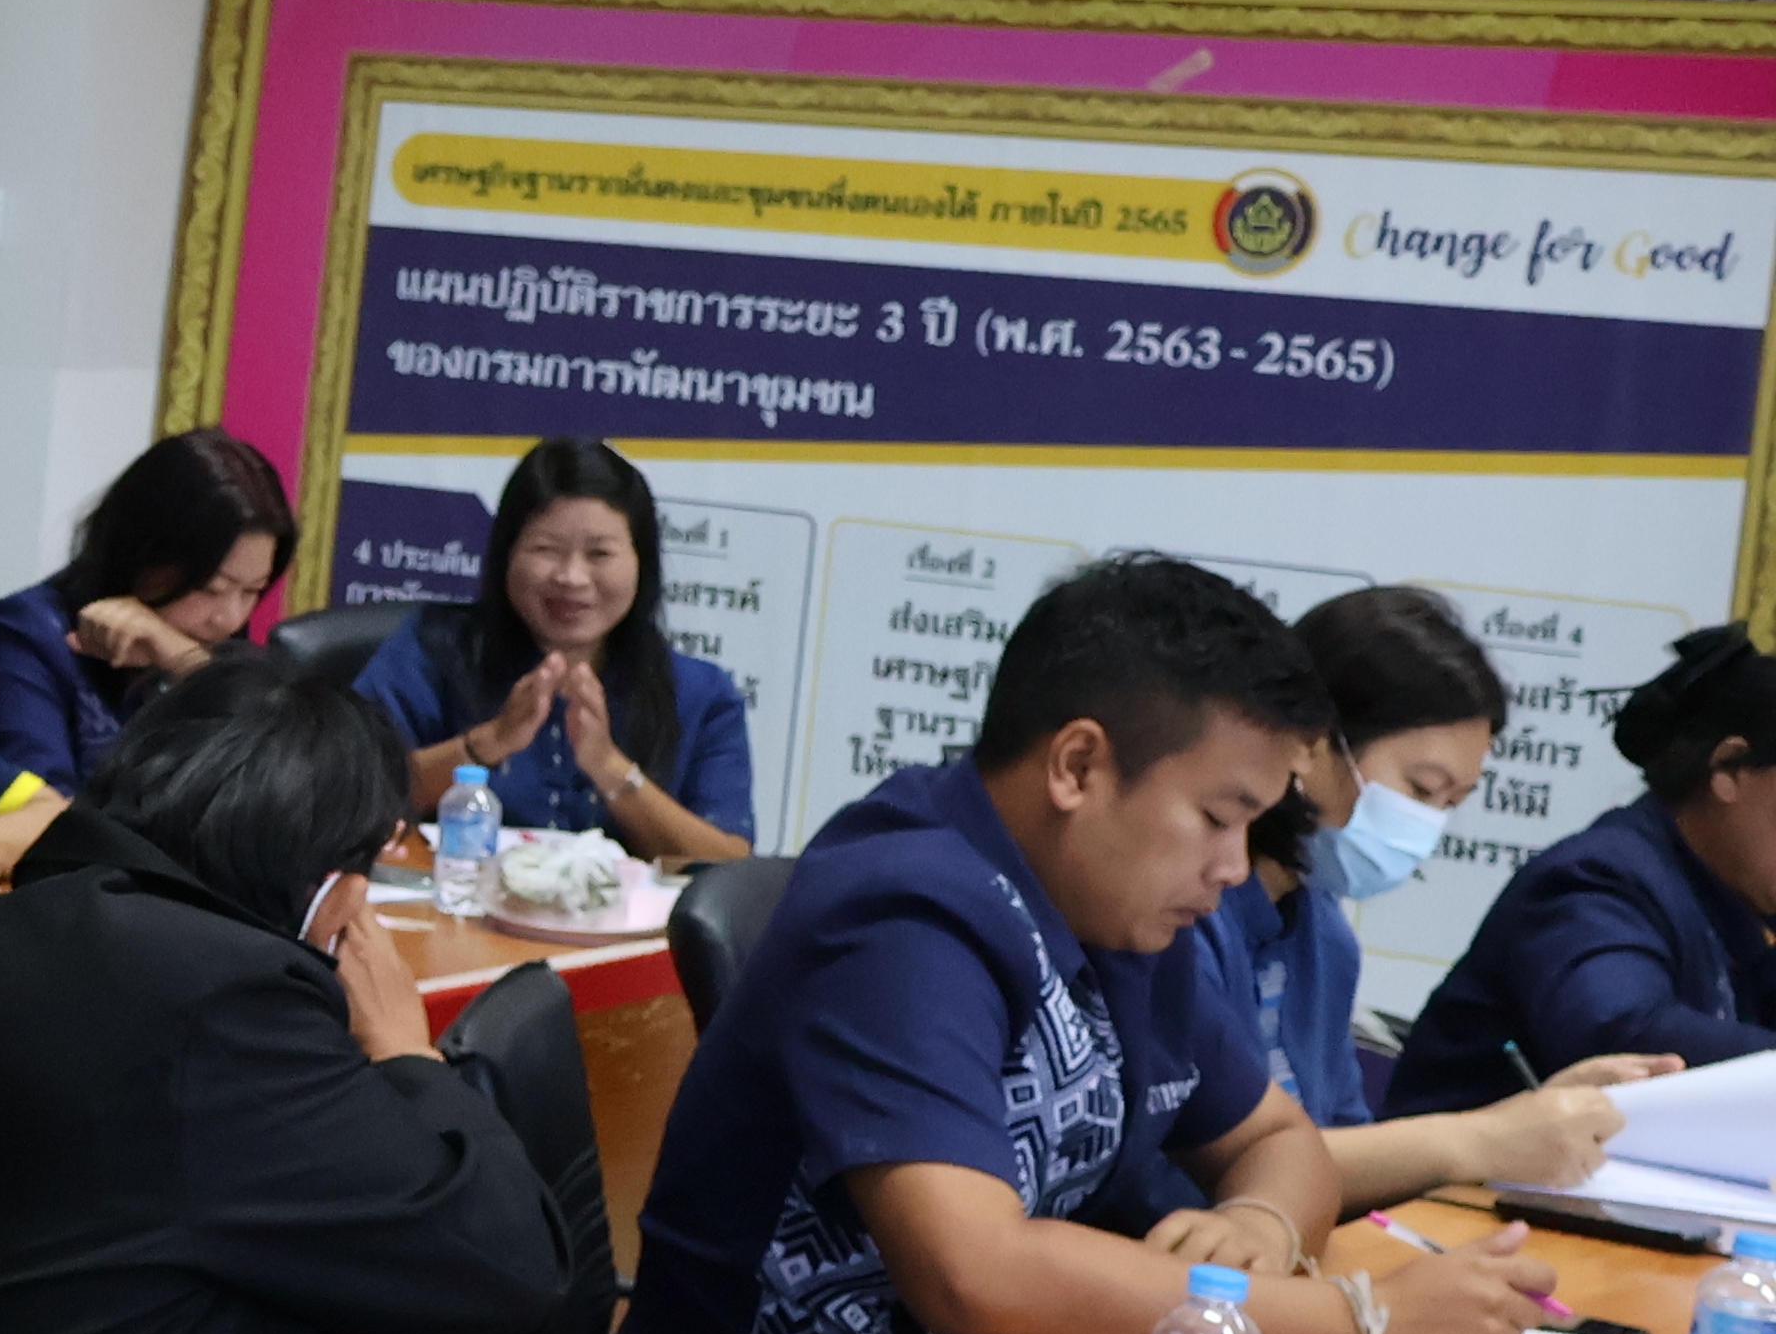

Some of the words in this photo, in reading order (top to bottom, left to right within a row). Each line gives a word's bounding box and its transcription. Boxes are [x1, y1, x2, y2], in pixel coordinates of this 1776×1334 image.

[1115, 205, 1189, 235] 2565
[1342, 207, 1520, 280] Change
[1526, 217, 1600, 287] for
[1613, 228, 1740, 282] Good
[395, 263, 861, 339] แผนปฏิบัติราชการระยะ
[875, 300, 906, 343] 3
[920, 295, 958, 348] ปี
[974, 306, 1085, 359] (พ.ศ.
[386, 338, 876, 428] ของกรมการพัฒนาชุมชน
